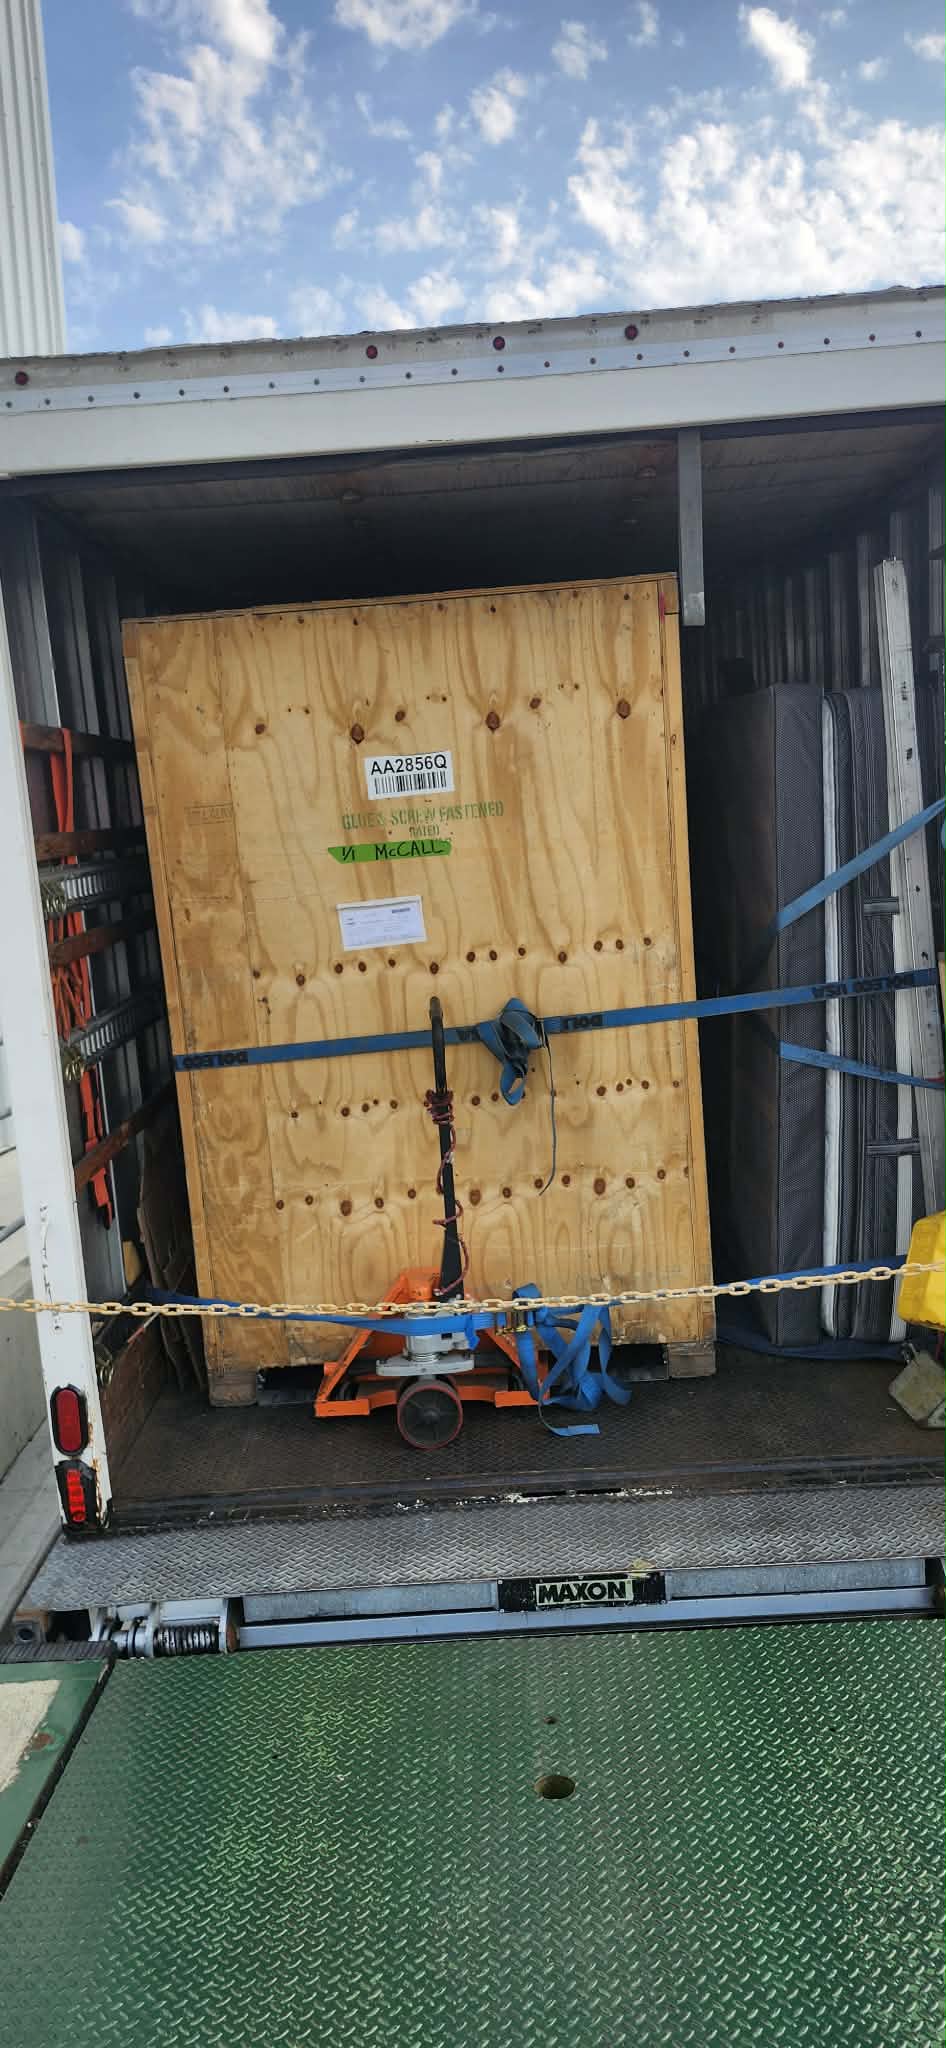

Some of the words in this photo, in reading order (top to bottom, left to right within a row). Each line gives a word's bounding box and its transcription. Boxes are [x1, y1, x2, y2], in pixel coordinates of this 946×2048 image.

[370, 754, 447, 775] AA2856Q
[439, 800, 504, 821] FASTENED
[375, 839, 443, 860] McCALL
[538, 1581, 627, 1603] MAXON
